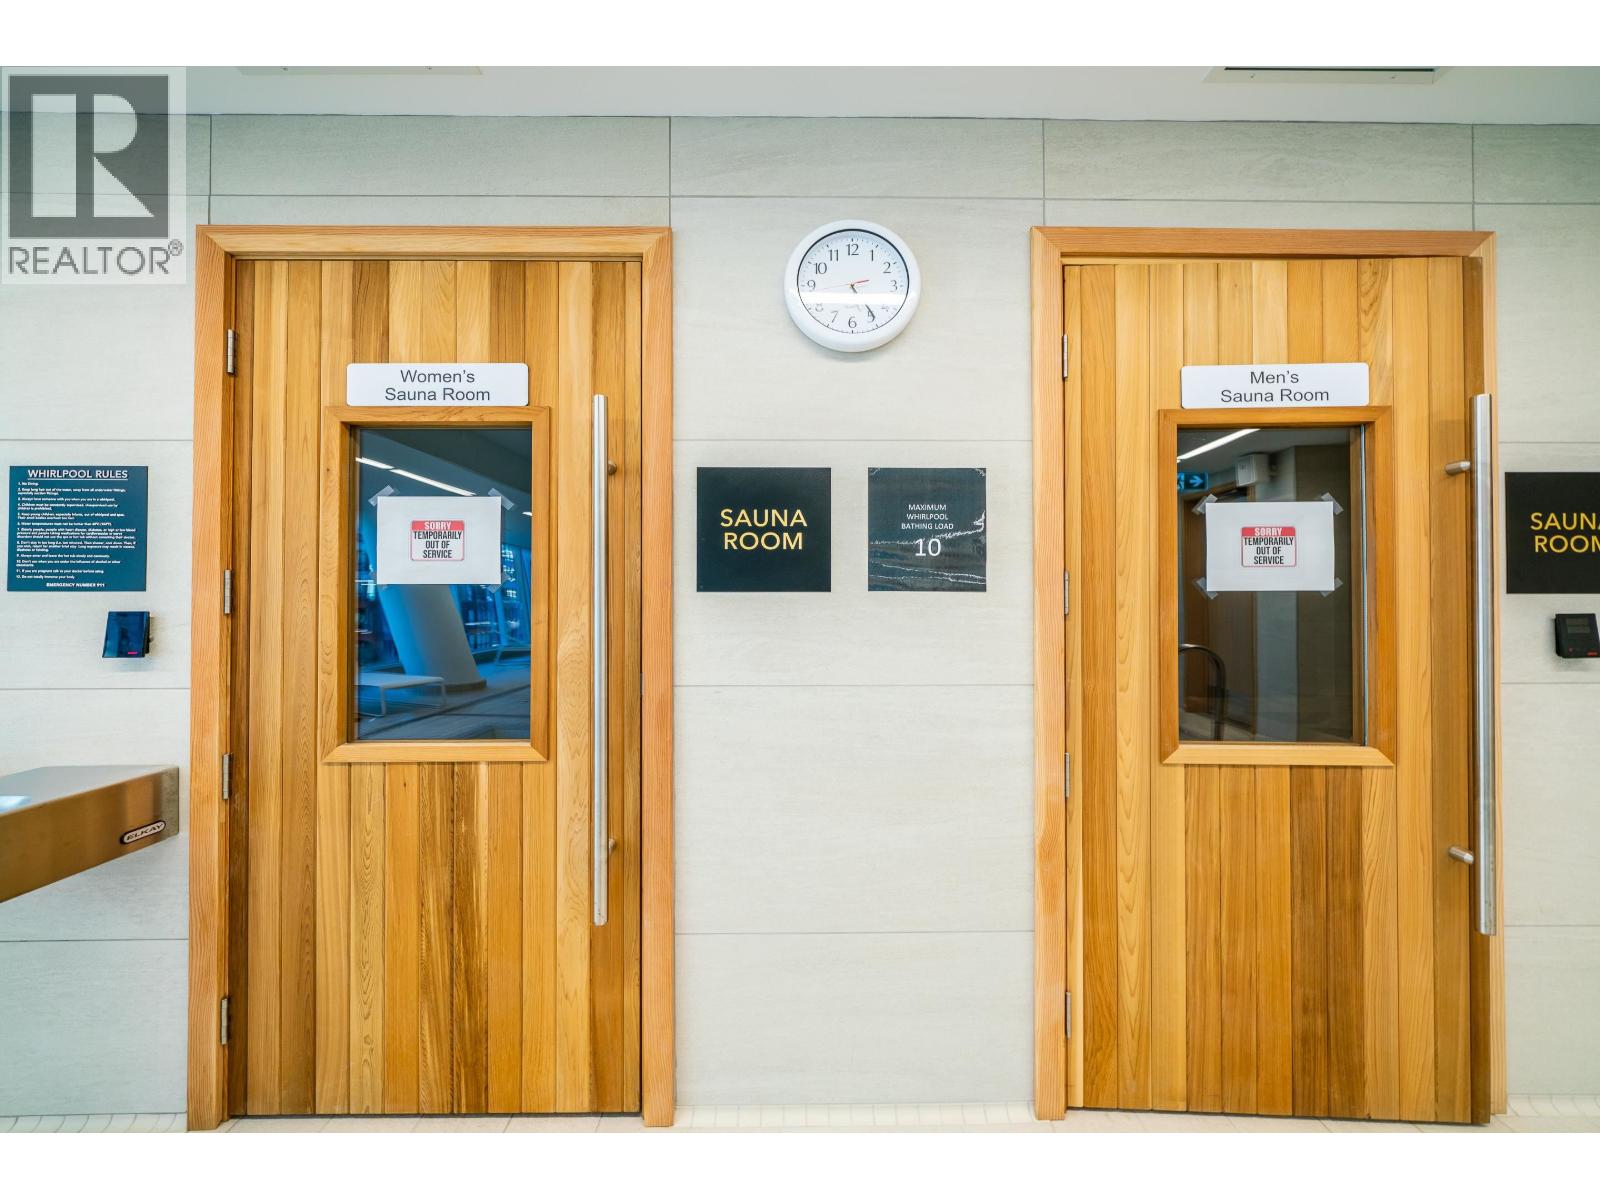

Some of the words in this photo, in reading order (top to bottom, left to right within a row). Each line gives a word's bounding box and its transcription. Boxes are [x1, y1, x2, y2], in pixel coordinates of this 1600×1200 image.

[829, 249, 839, 262] 11
[846, 244, 859, 256] 12
[814, 262, 828, 274] 10
[882, 262, 891, 274] 2
[806, 280, 816, 291] 9
[890, 280, 898, 292] 3
[831, 310, 838, 323] 7
[848, 316, 857, 328] 6
[400, 370, 476, 383] Women's
[1250, 370, 1300, 384] Men's
[384, 388, 437, 401] Sauna
[442, 388, 490, 401] Room
[1220, 390, 1274, 403] Sauna
[1280, 388, 1330, 402] Room
[28, 469, 92, 478] WHIRLPOOL
[95, 470, 128, 478] RULES
[720, 508, 808, 527] SAUNA
[1530, 512, 1600, 530] SAUN
[424, 521, 451, 530] SORRY
[414, 531, 462, 540] TEMPORARILY
[1254, 528, 1282, 536] SORRY
[426, 540, 439, 549] OUT
[441, 540, 450, 549] OF
[724, 532, 803, 550] ROOM
[1244, 537, 1293, 545] TEMPORARILY
[915, 538, 942, 557] 10
[1256, 546, 1270, 555] OUT
[1272, 546, 1281, 555] OF
[423, 550, 452, 558] SERVICE
[1254, 556, 1284, 564] SERVICE
[126, 823, 164, 841] ELKAY
